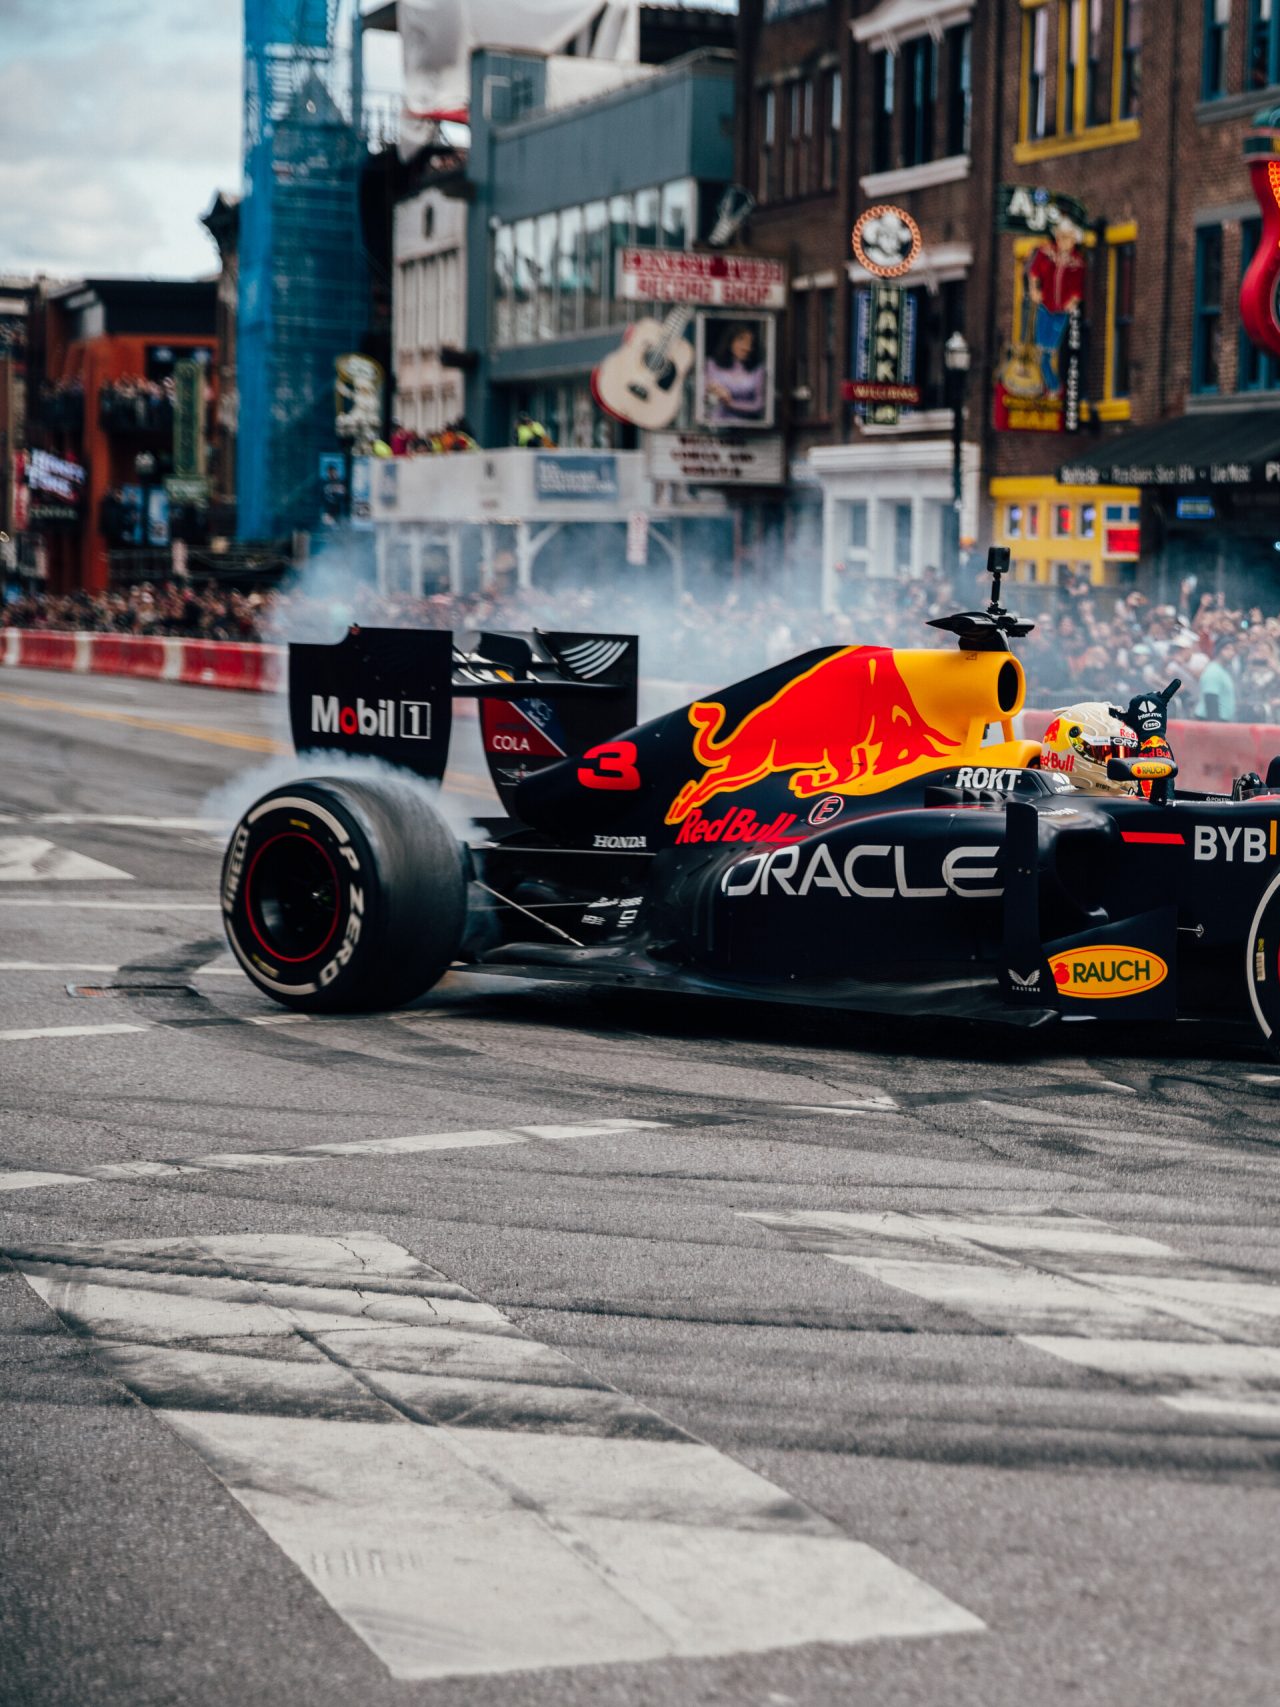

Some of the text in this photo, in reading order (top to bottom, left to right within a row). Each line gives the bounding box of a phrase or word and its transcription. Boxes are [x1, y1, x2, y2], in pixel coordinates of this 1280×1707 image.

[311, 695, 395, 737] Mobil
[493, 735, 531, 751] COLA
[577, 741, 641, 790] 3
[1051, 752, 1075, 772] Bull
[1142, 767, 1166, 775] RAUCH
[955, 767, 1022, 791] ROKT
[675, 806, 809, 844] Red Bull
[594, 835, 647, 848] HONDA
[222, 826, 250, 913] PIRELLI
[721, 843, 1005, 898] ORACLE
[319, 846, 365, 987] P ZERO
[1073, 960, 1150, 983] RAUCH
